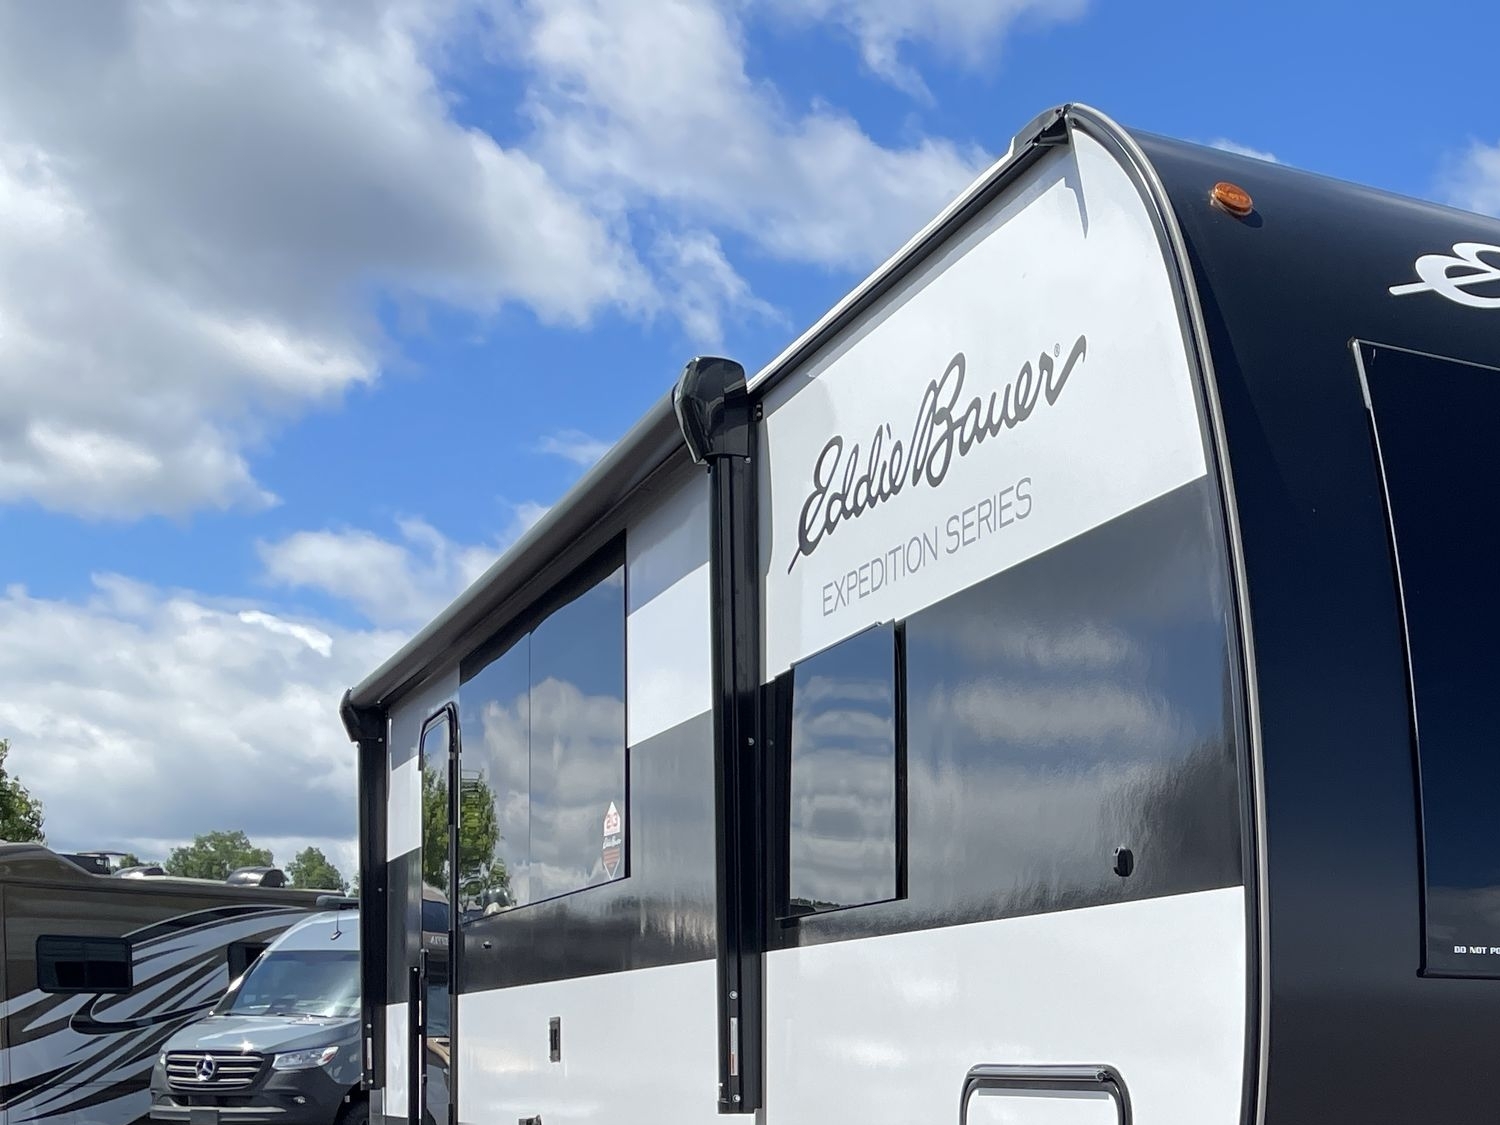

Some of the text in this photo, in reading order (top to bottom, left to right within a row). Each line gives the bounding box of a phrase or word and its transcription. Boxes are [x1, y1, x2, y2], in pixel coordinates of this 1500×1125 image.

[787, 334, 1087, 575] Eddie Bauer
[822, 477, 1033, 617] EXPEDITION SERIES
[1453, 945, 1467, 954] DO
[1469, 946, 1487, 955] NOT
